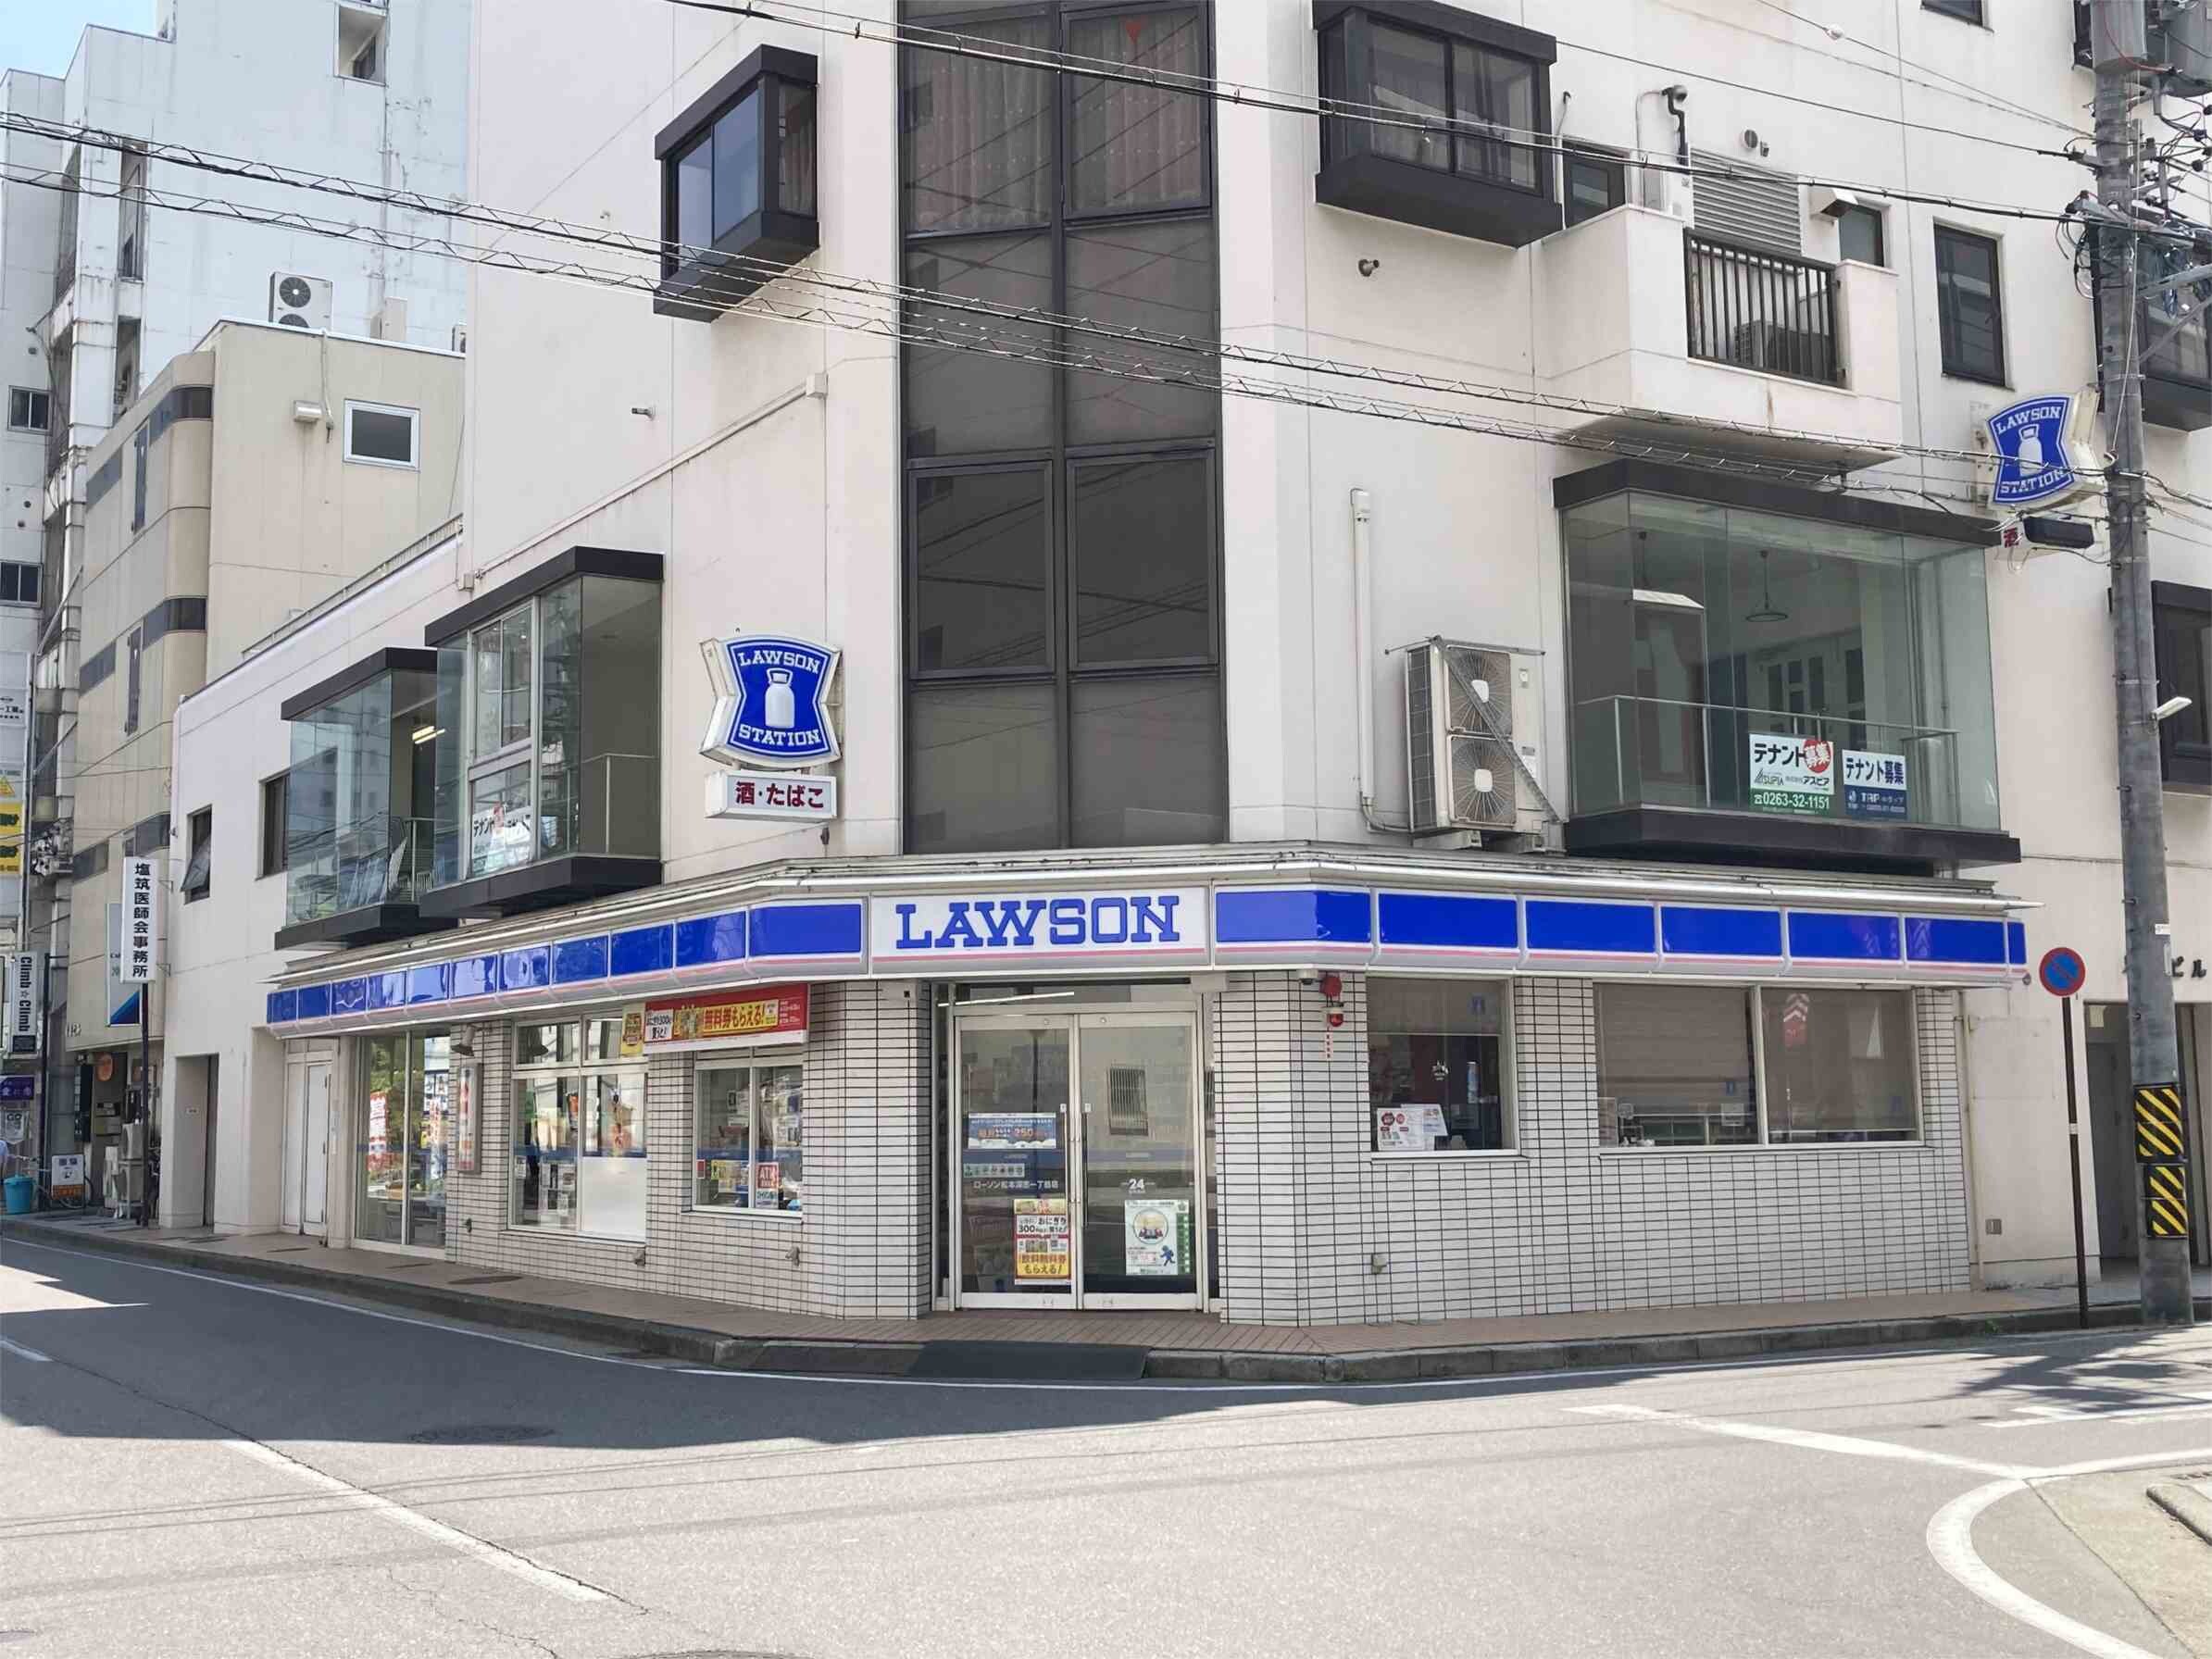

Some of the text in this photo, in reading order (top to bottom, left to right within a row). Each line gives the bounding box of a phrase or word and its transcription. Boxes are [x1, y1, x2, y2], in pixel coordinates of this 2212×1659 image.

[1996, 405, 2061, 434] LAWSON
[2000, 467, 2068, 493] STATION
[738, 650, 821, 674] LAWSON
[738, 722, 821, 746] STATION
[1845, 756, 1906, 785] テナント募集
[132, 862, 150, 979] 塩筑医師会事務所
[895, 895, 1181, 950] LAWSON
[1129, 1178, 1145, 1190] 24
